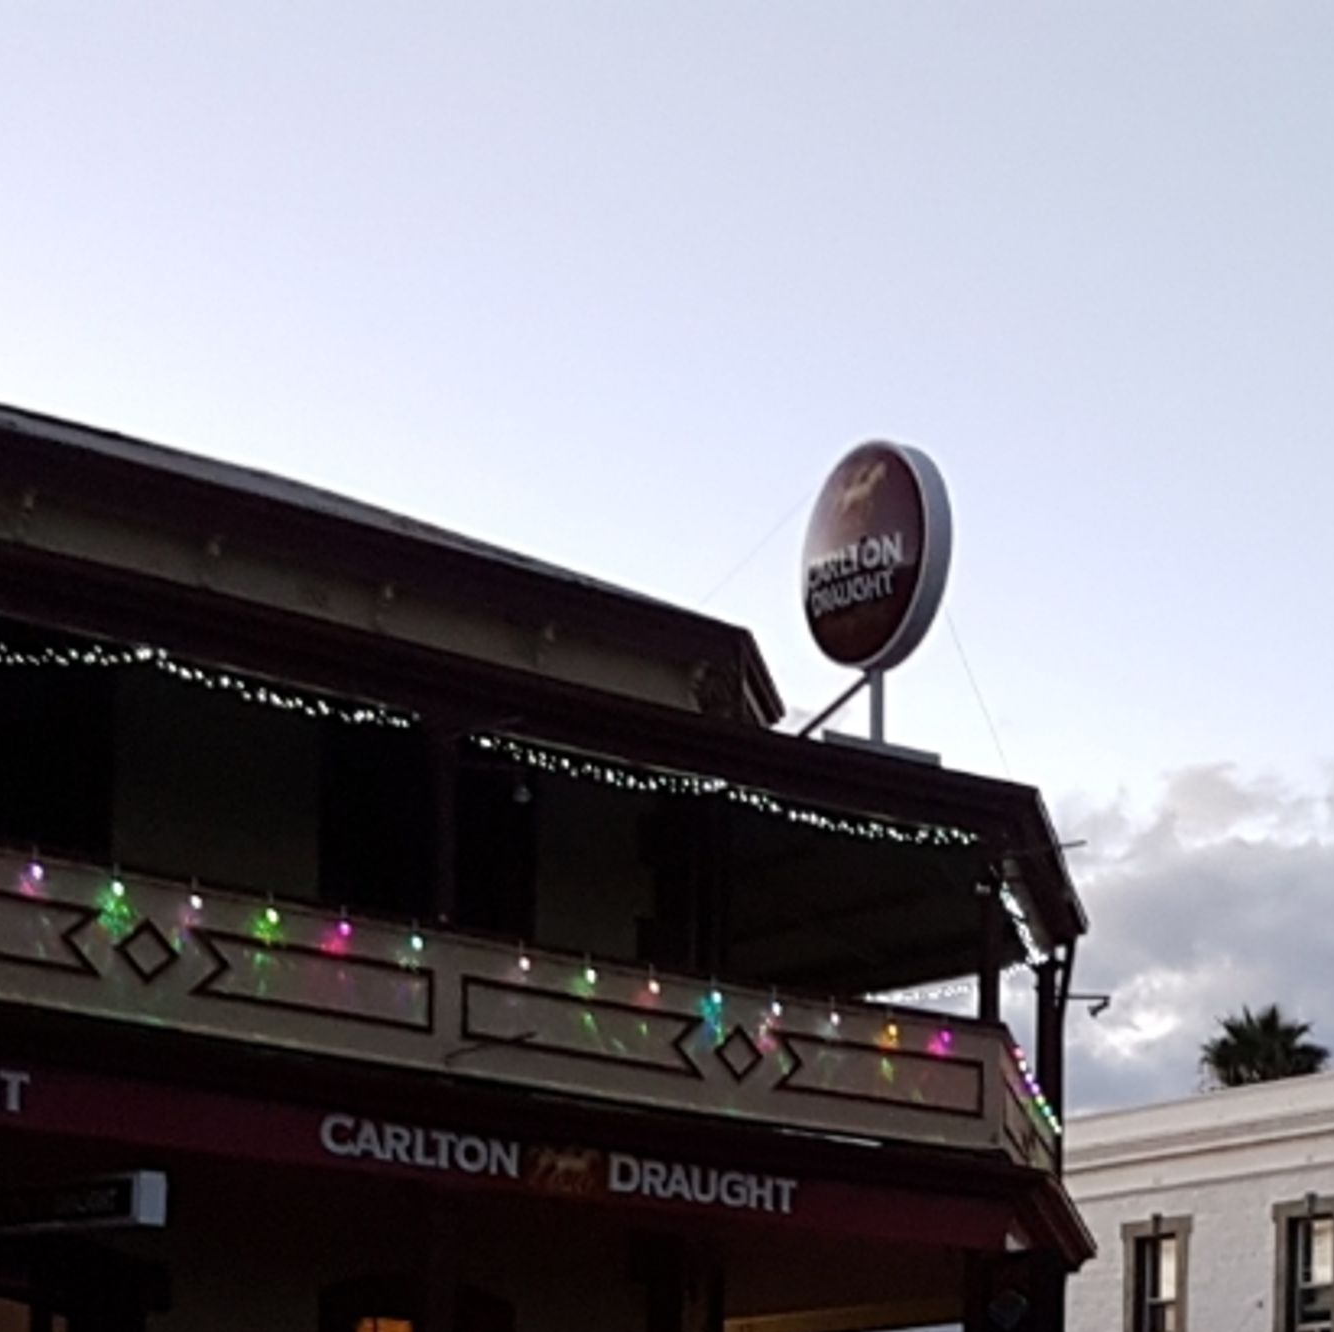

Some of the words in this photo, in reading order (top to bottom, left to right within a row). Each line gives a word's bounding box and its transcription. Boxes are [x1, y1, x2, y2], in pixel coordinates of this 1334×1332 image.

[809, 531, 903, 589] CARLTON
[811, 568, 894, 617] DRAUGHT
[320, 1113, 521, 1178] CARLTON
[608, 1154, 798, 1214] DRAUGHT
